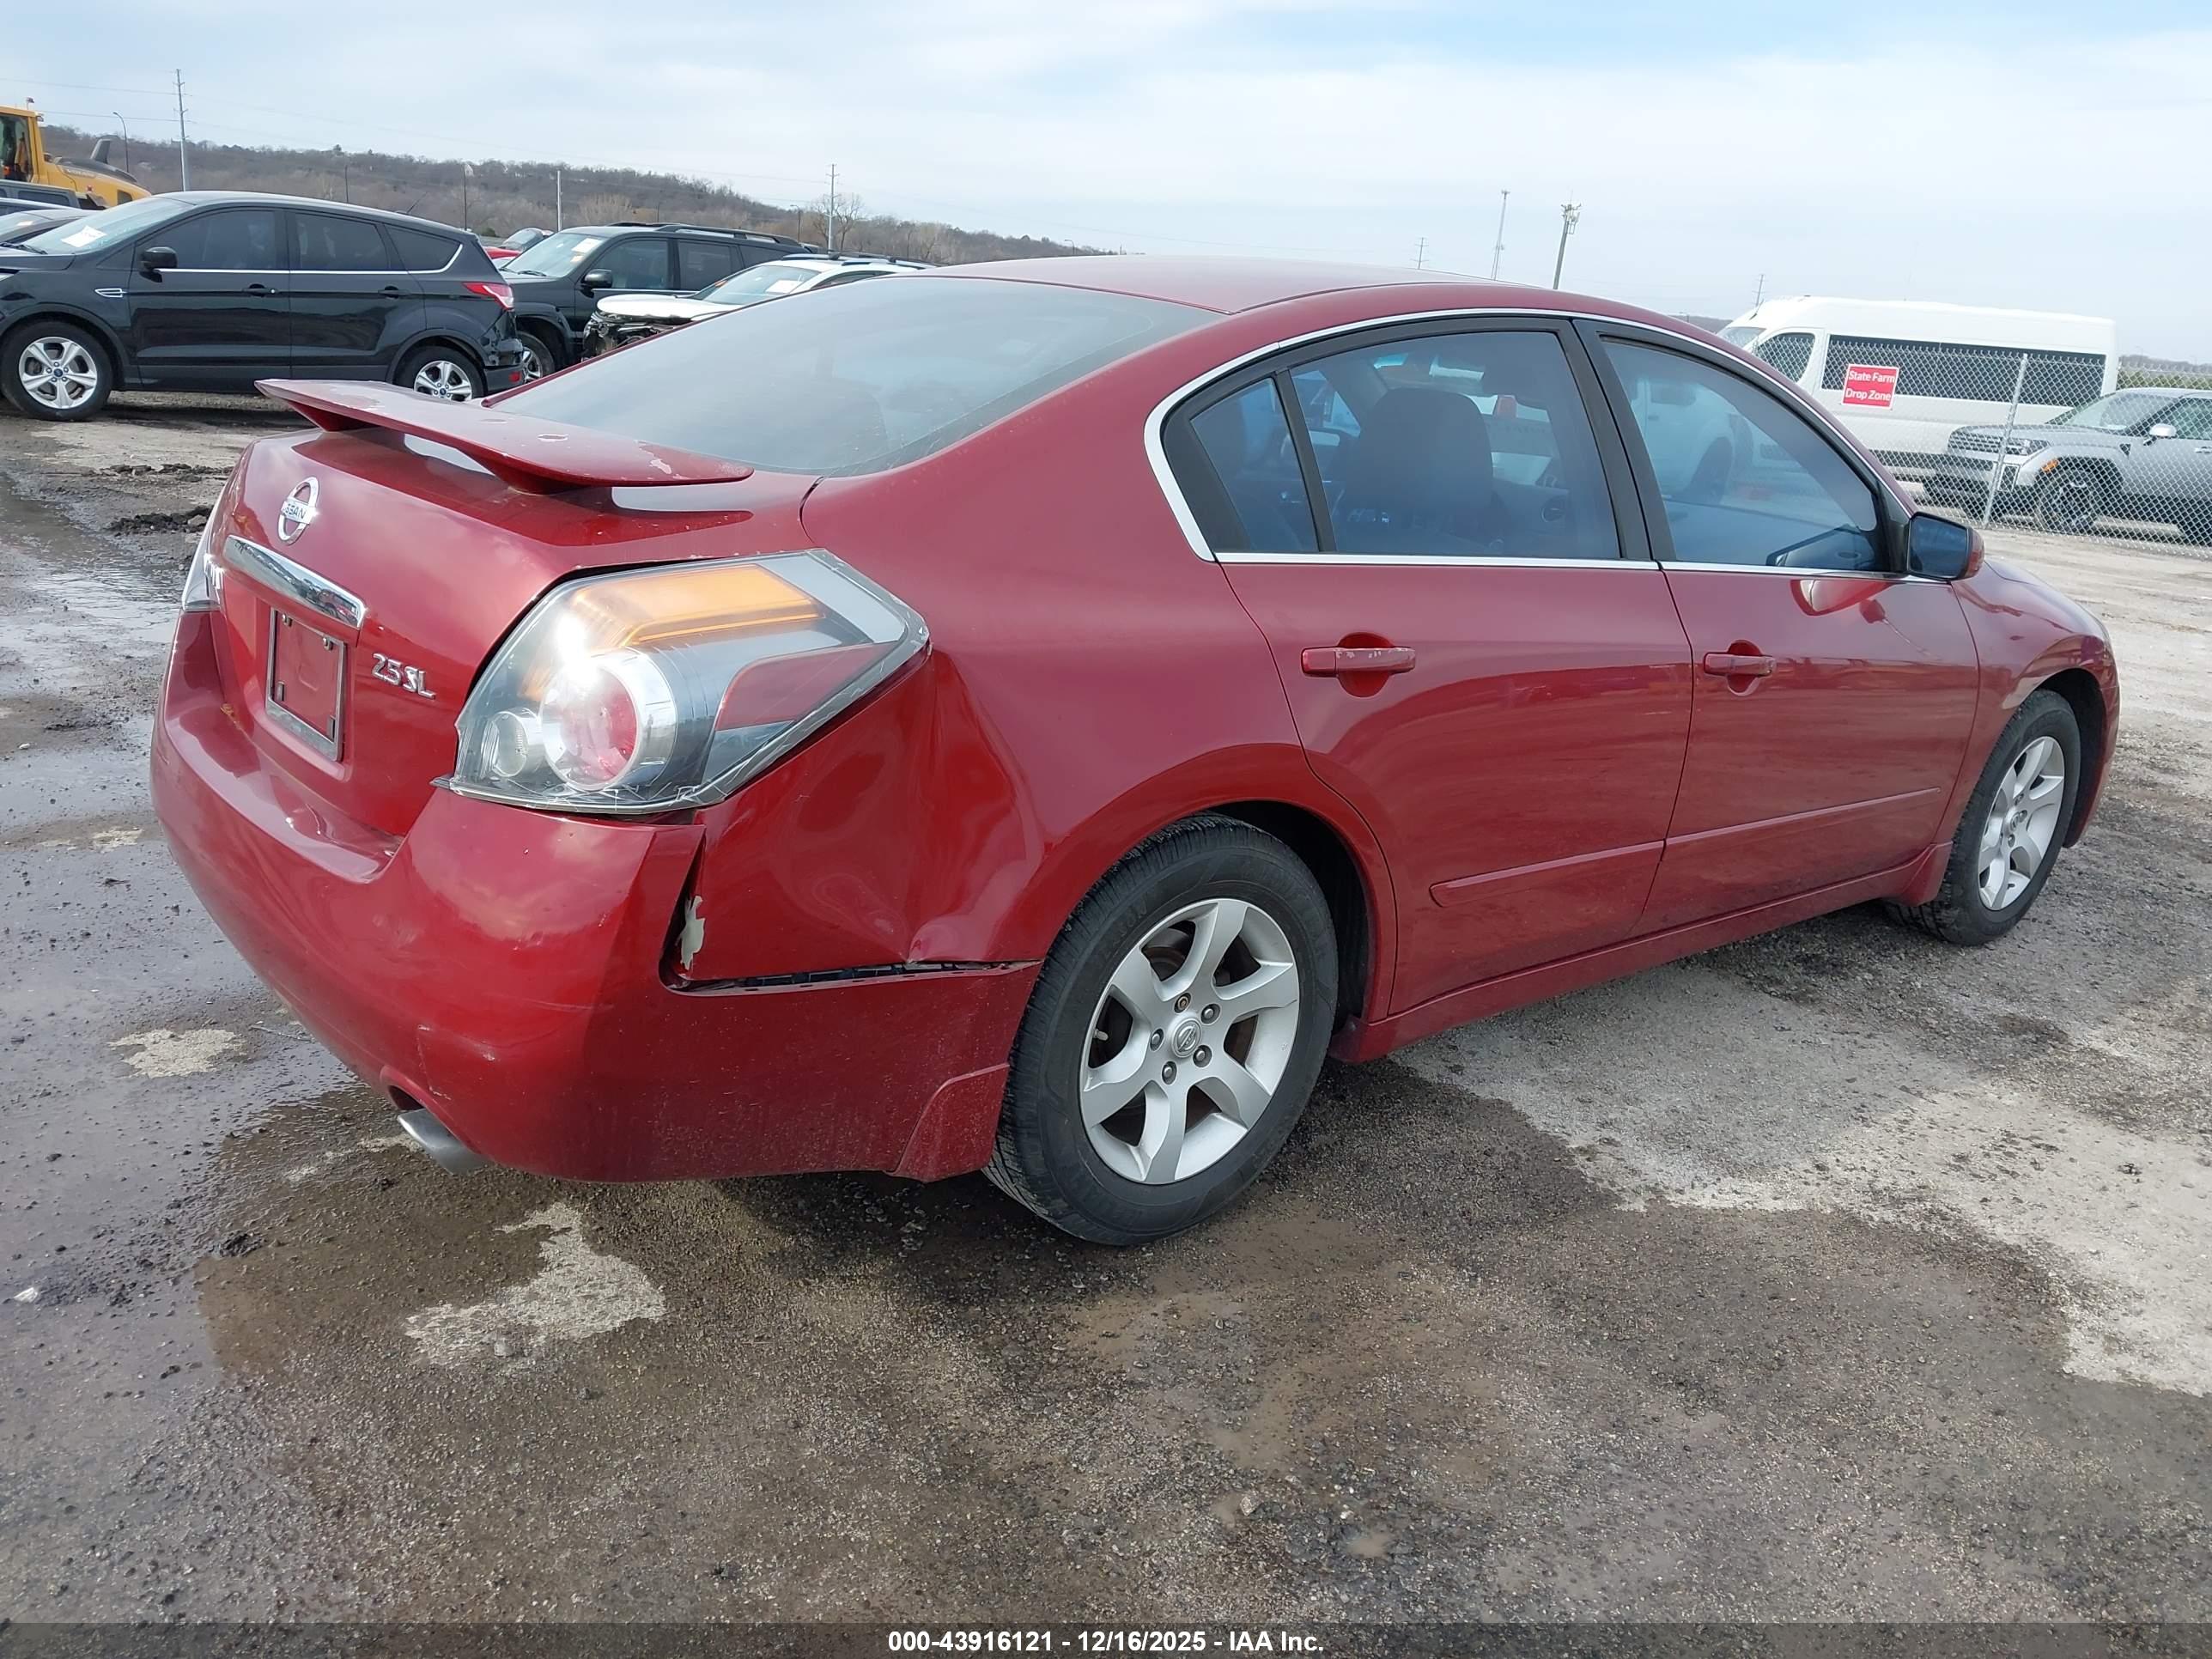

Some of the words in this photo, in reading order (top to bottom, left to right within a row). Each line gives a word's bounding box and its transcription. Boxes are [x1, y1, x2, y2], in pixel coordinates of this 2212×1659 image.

[1848, 370, 1871, 381] State
[1872, 372, 1895, 383] Farm
[1844, 388, 1868, 400] Drop
[1868, 390, 1892, 401] Zone
[403, 665, 436, 700] SL
